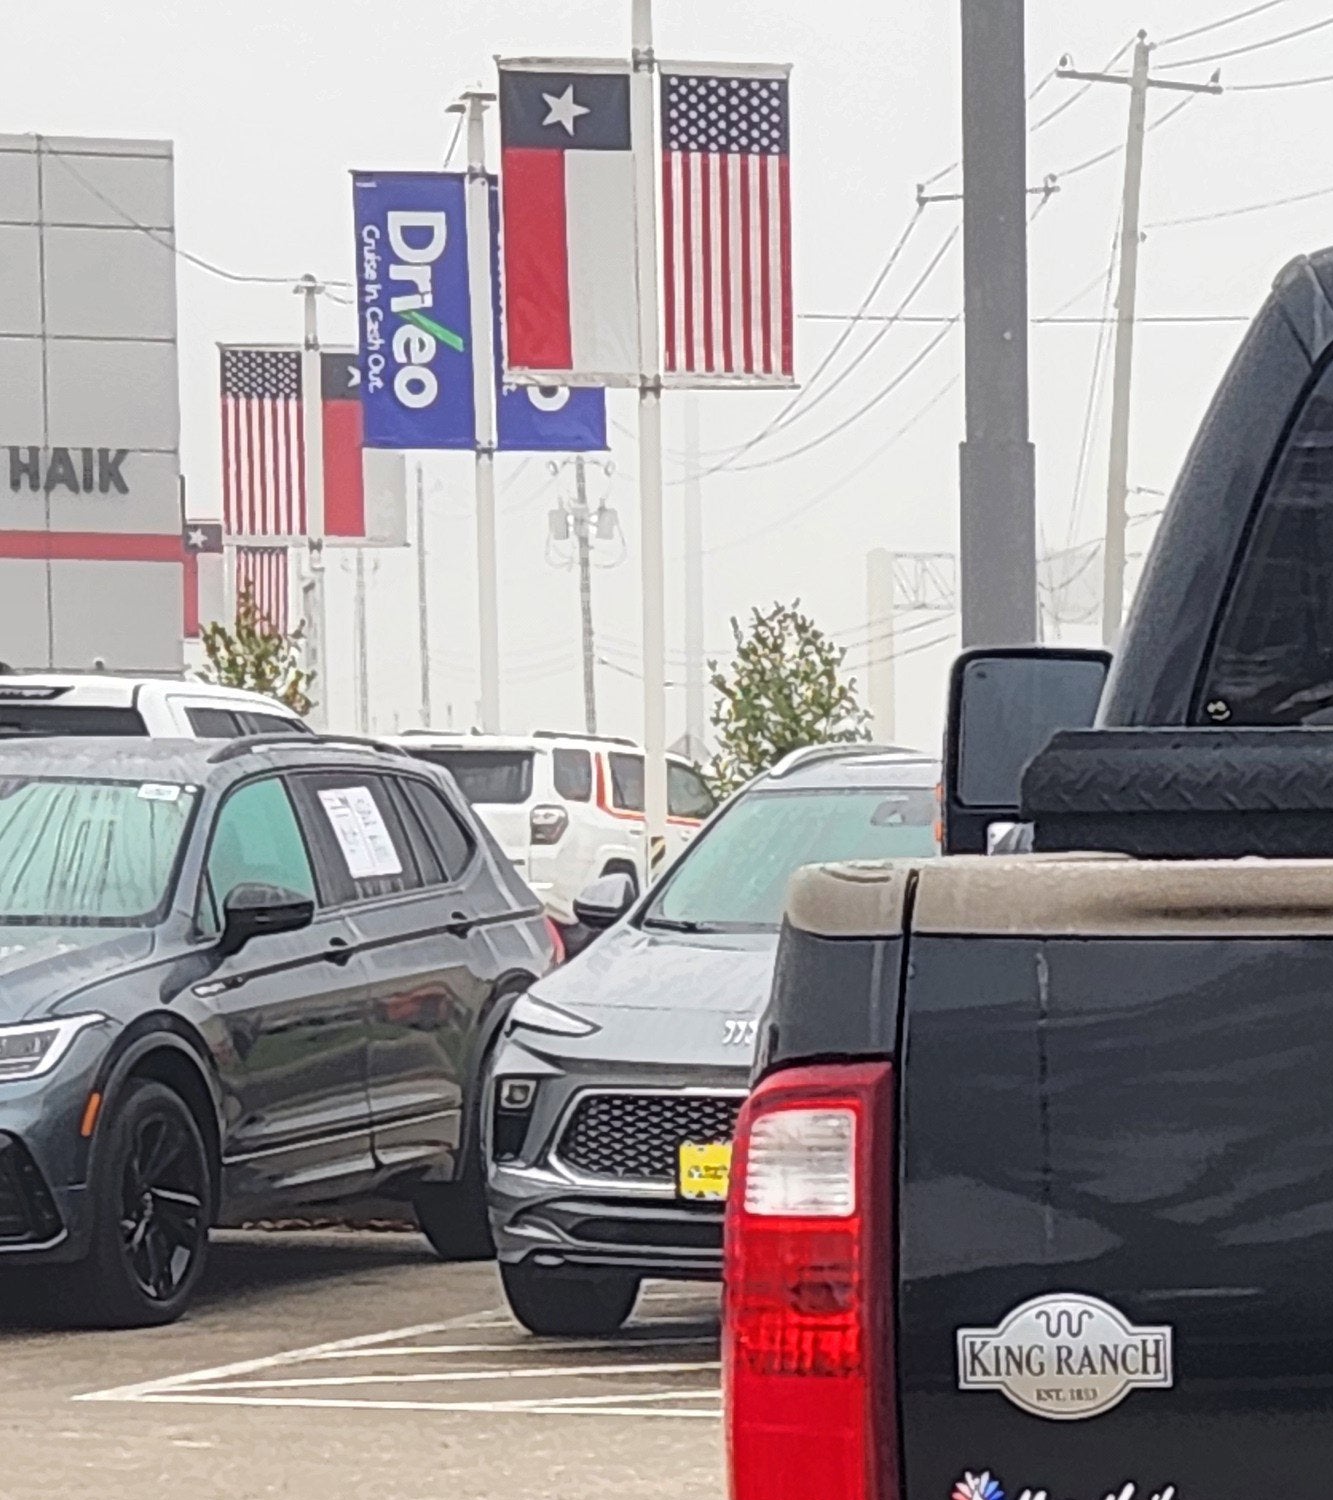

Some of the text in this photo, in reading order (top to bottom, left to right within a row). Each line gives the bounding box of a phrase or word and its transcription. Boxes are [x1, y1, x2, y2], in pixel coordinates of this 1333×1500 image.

[362, 225, 385, 393] Cruise In Cash Out
[8, 445, 130, 494] HAIK
[969, 1339, 1163, 1377] KING RANCH
